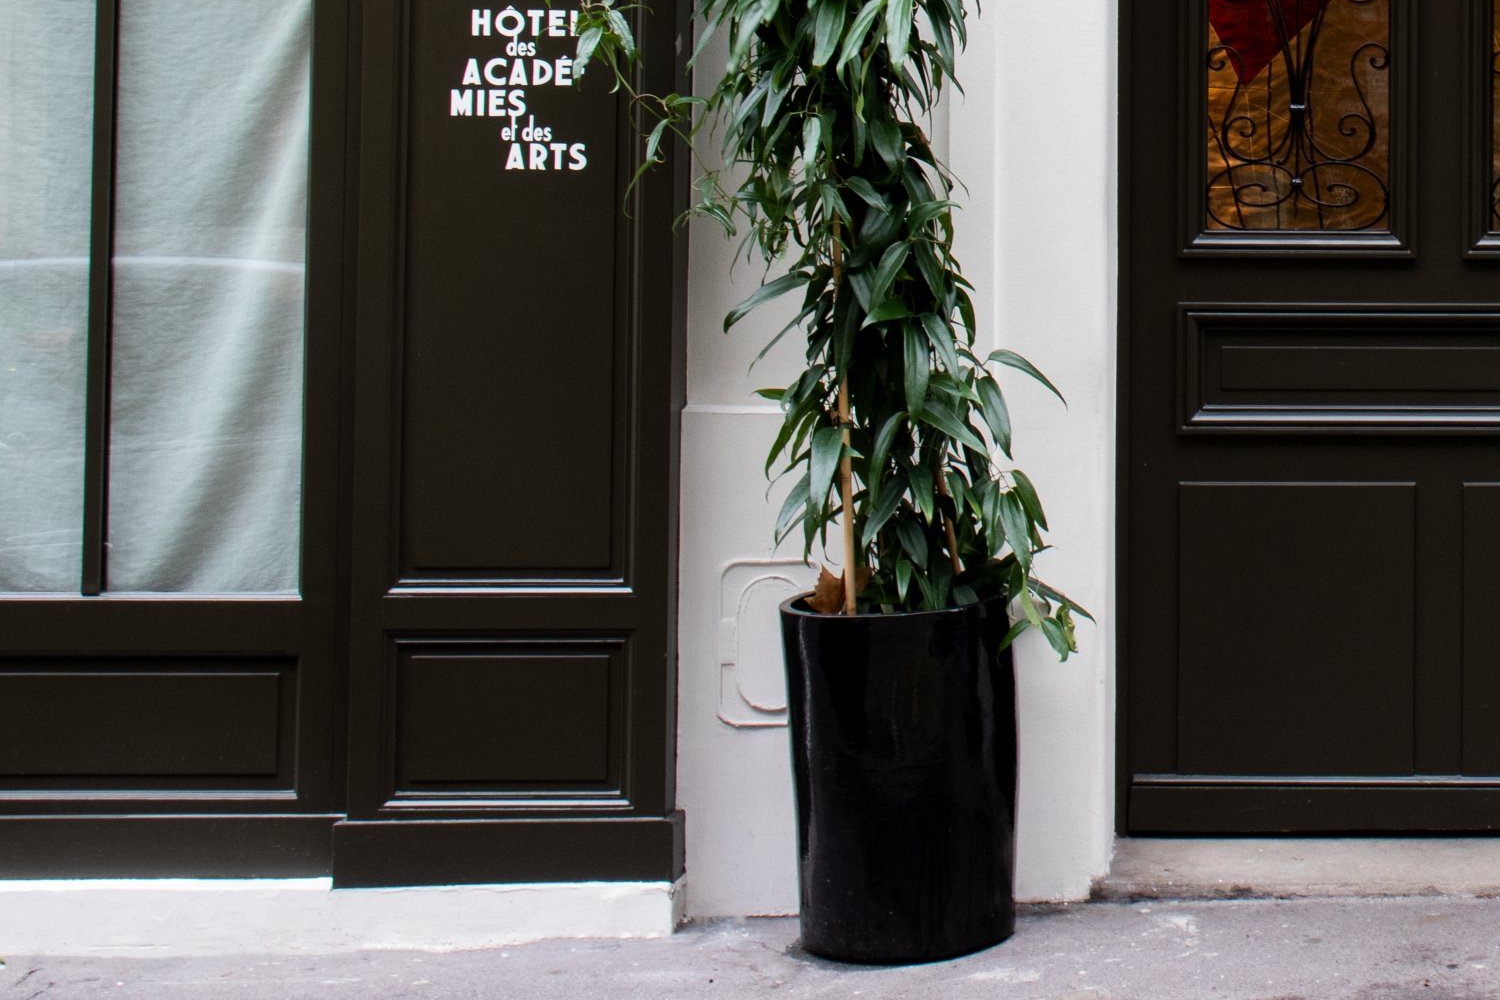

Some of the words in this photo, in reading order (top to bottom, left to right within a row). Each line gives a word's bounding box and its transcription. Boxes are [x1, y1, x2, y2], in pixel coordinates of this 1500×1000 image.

[505, 35, 536, 57] des
[450, 89, 527, 117] MIES
[501, 116, 518, 142] et
[521, 115, 552, 142] des
[505, 143, 588, 171] ARTS
